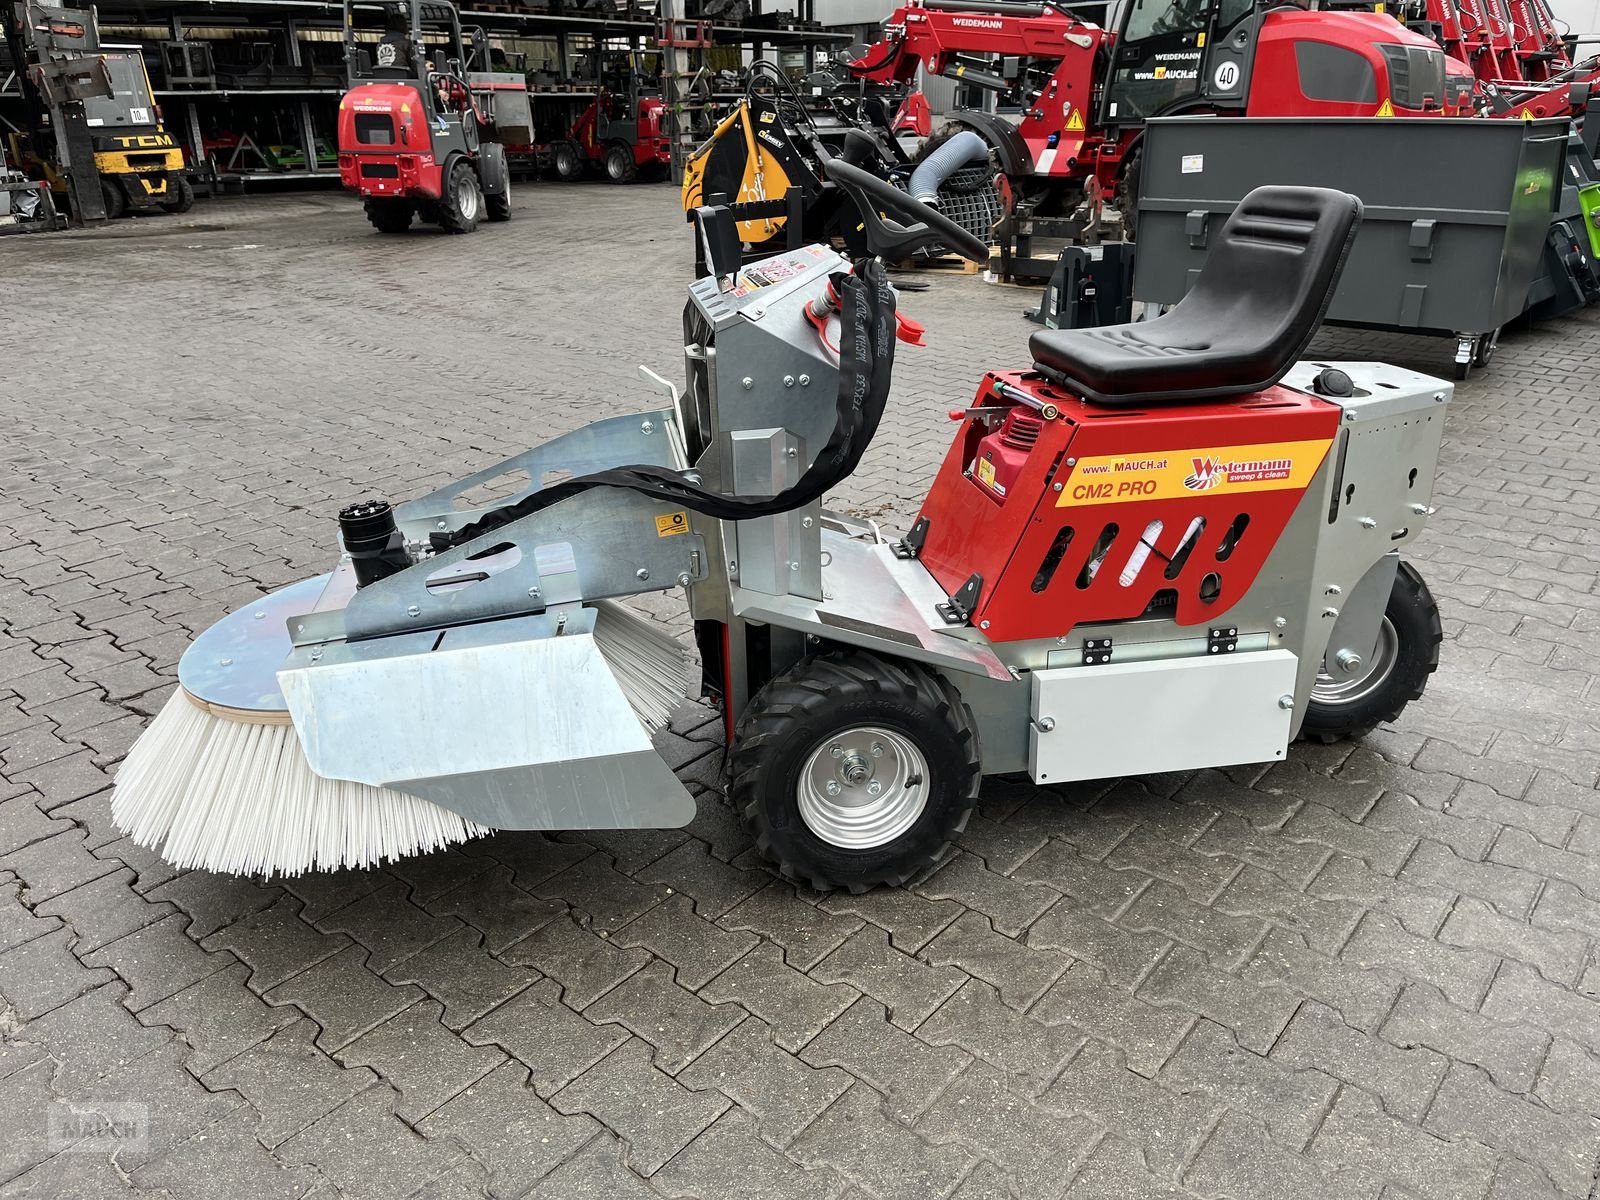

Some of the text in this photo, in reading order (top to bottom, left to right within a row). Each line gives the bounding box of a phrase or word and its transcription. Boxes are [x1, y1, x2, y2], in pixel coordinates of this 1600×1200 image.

[953, 17, 1002, 29] WEIDEMANN
[1520, 2, 1533, 37] WEIDEMANN
[1135, 68, 1197, 80] www.MAUCH.at
[1219, 67, 1234, 84] 40
[133, 110, 141, 121] 10
[113, 135, 173, 147] TCM
[856, 333, 867, 363] MSHA
[852, 372, 866, 411] TEXS33
[1191, 456, 1292, 478] Westermann
[1229, 471, 1255, 482] sweep
[1264, 470, 1289, 479] clean.
[1073, 480, 1157, 500] CM2 PRO
